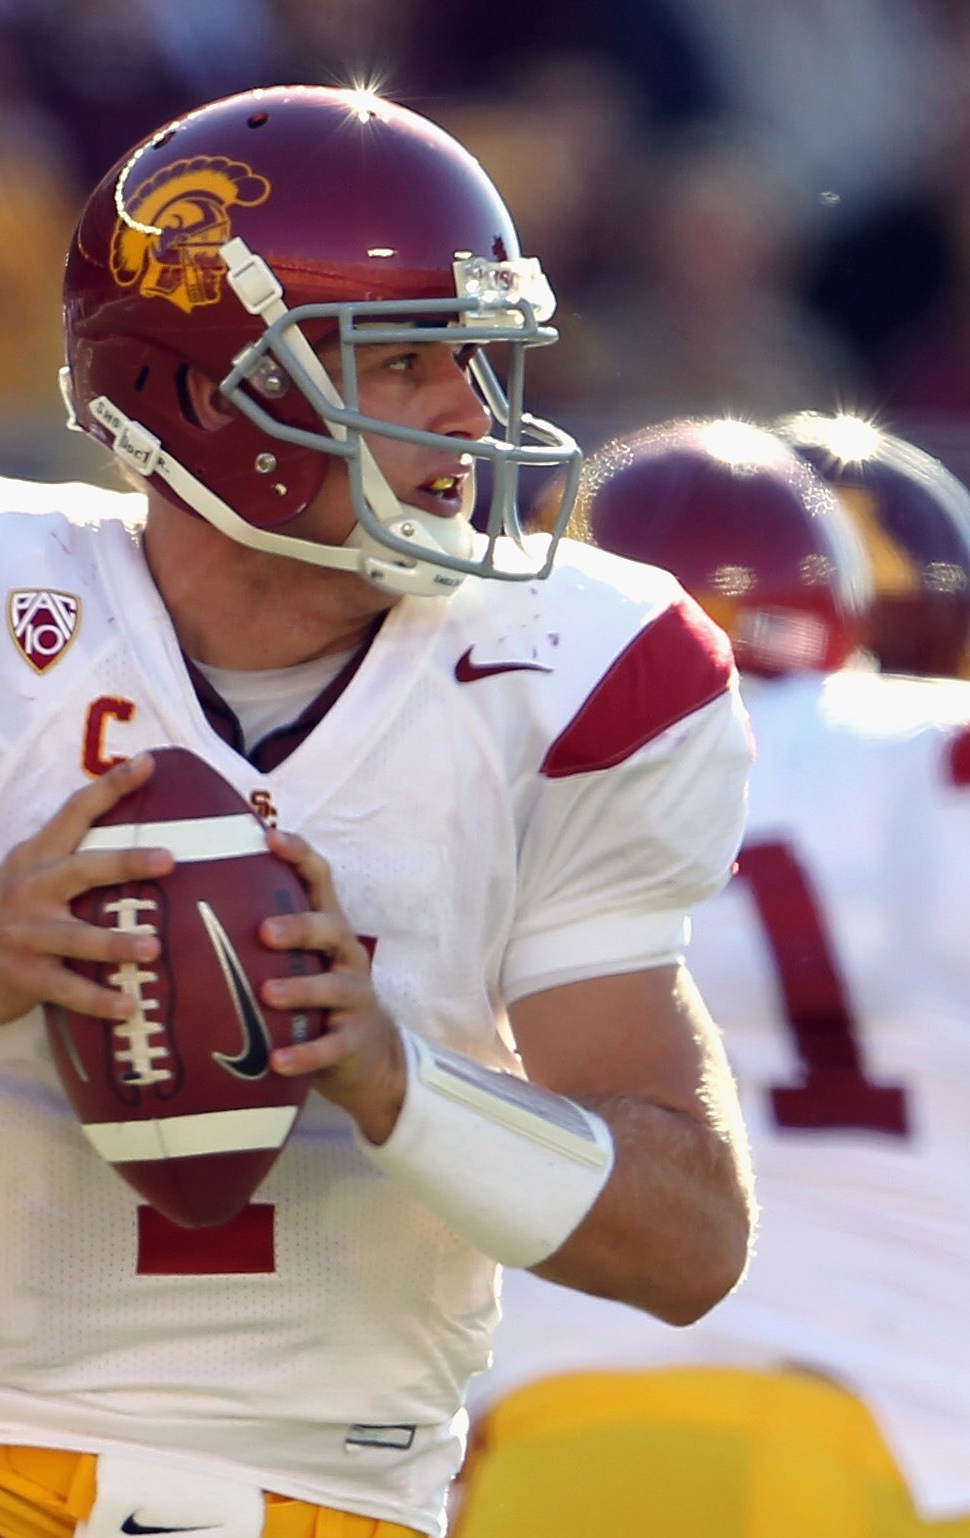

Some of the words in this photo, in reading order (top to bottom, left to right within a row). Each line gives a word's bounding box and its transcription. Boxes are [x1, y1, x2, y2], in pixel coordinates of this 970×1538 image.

[10, 591, 78, 641] PAC
[24, 623, 66, 656] 10
[83, 693, 137, 780] C
